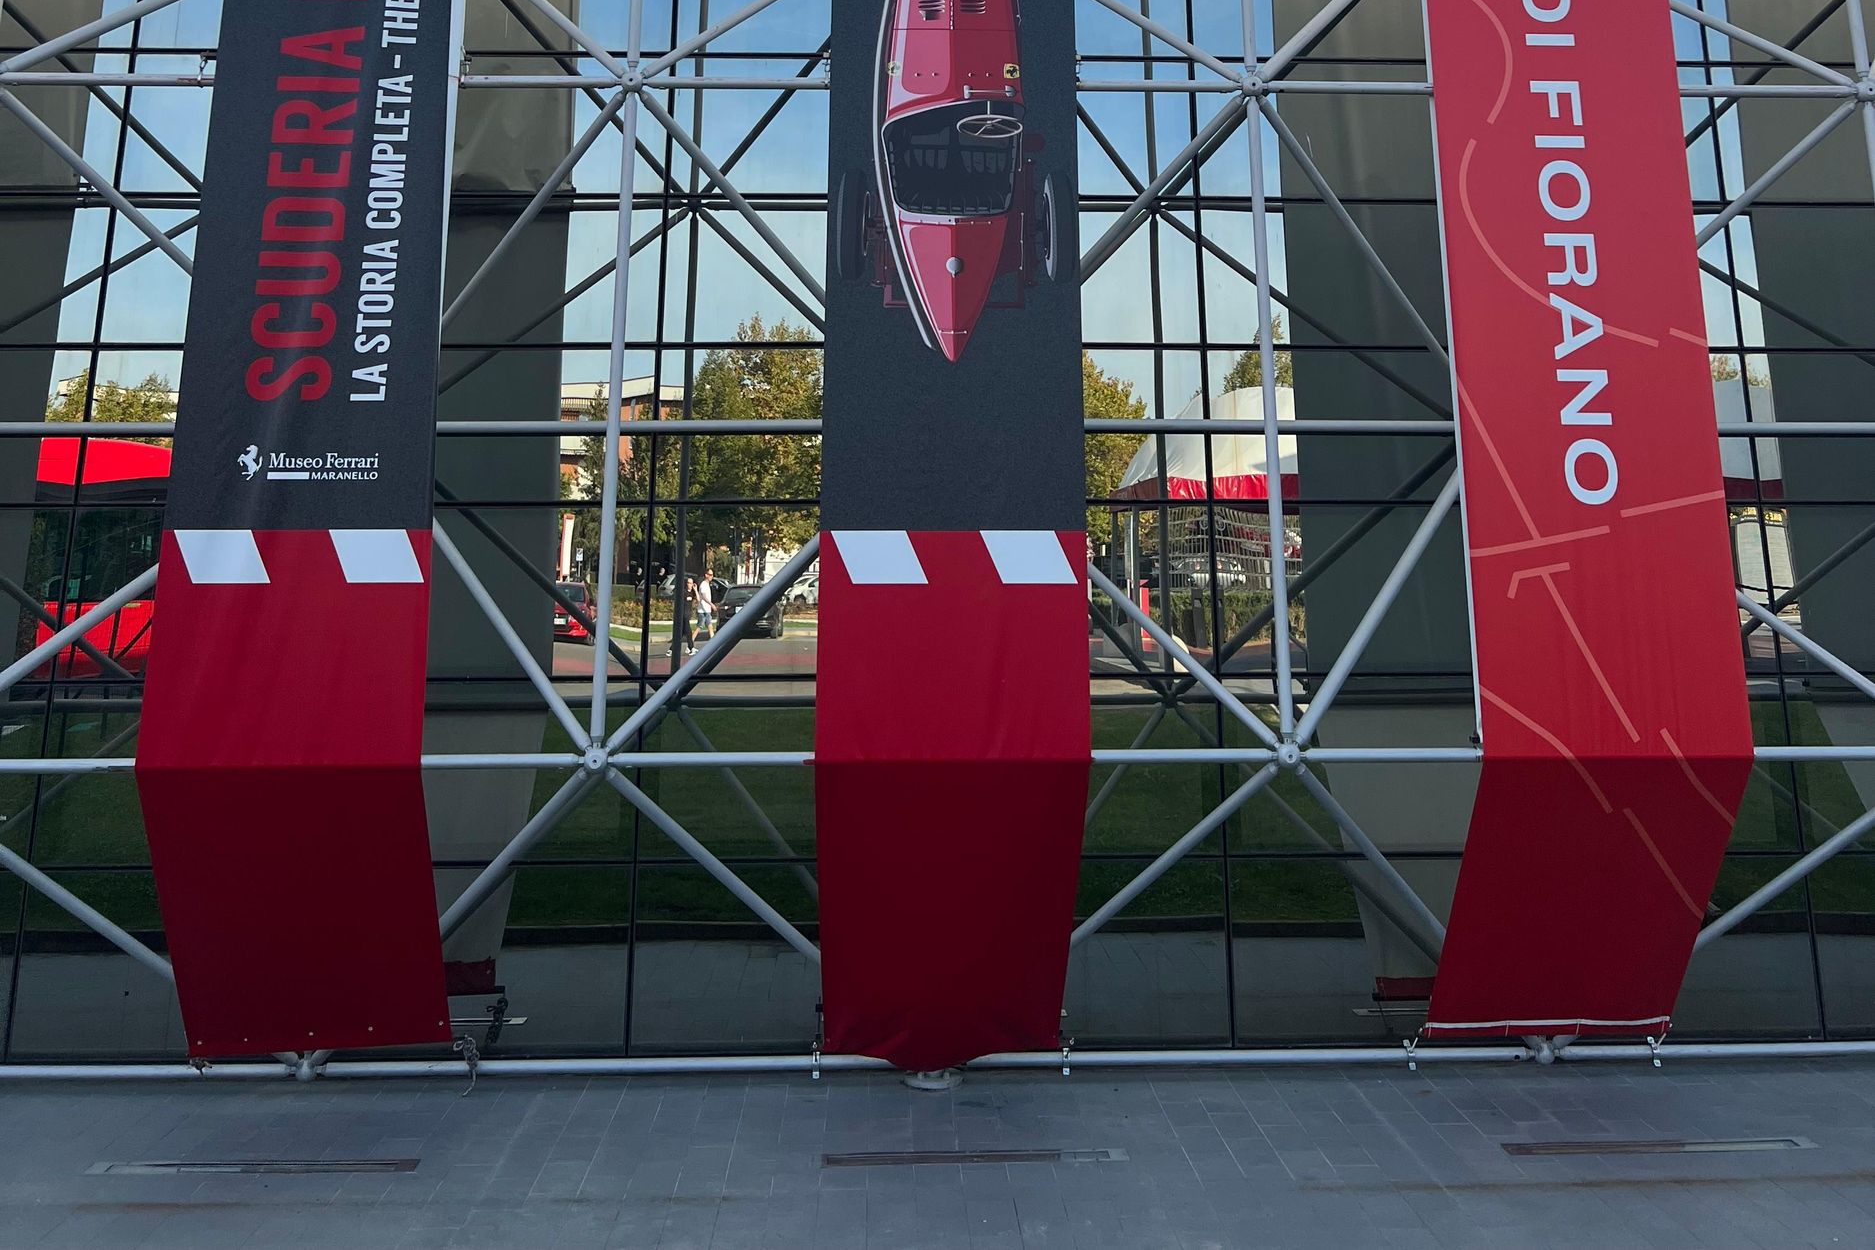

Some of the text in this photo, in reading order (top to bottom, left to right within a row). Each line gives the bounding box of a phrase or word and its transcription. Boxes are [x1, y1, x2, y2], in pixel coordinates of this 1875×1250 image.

[366, 74, 414, 229] COMPLETA
[246, 27, 365, 401] SCUDERIA
[355, 239, 399, 354] STORIA
[1529, 80, 1619, 505] FIORANO
[350, 363, 389, 402] LA
[268, 452, 379, 469] Museo Ferrari
[311, 471, 379, 480] MARANELLO
